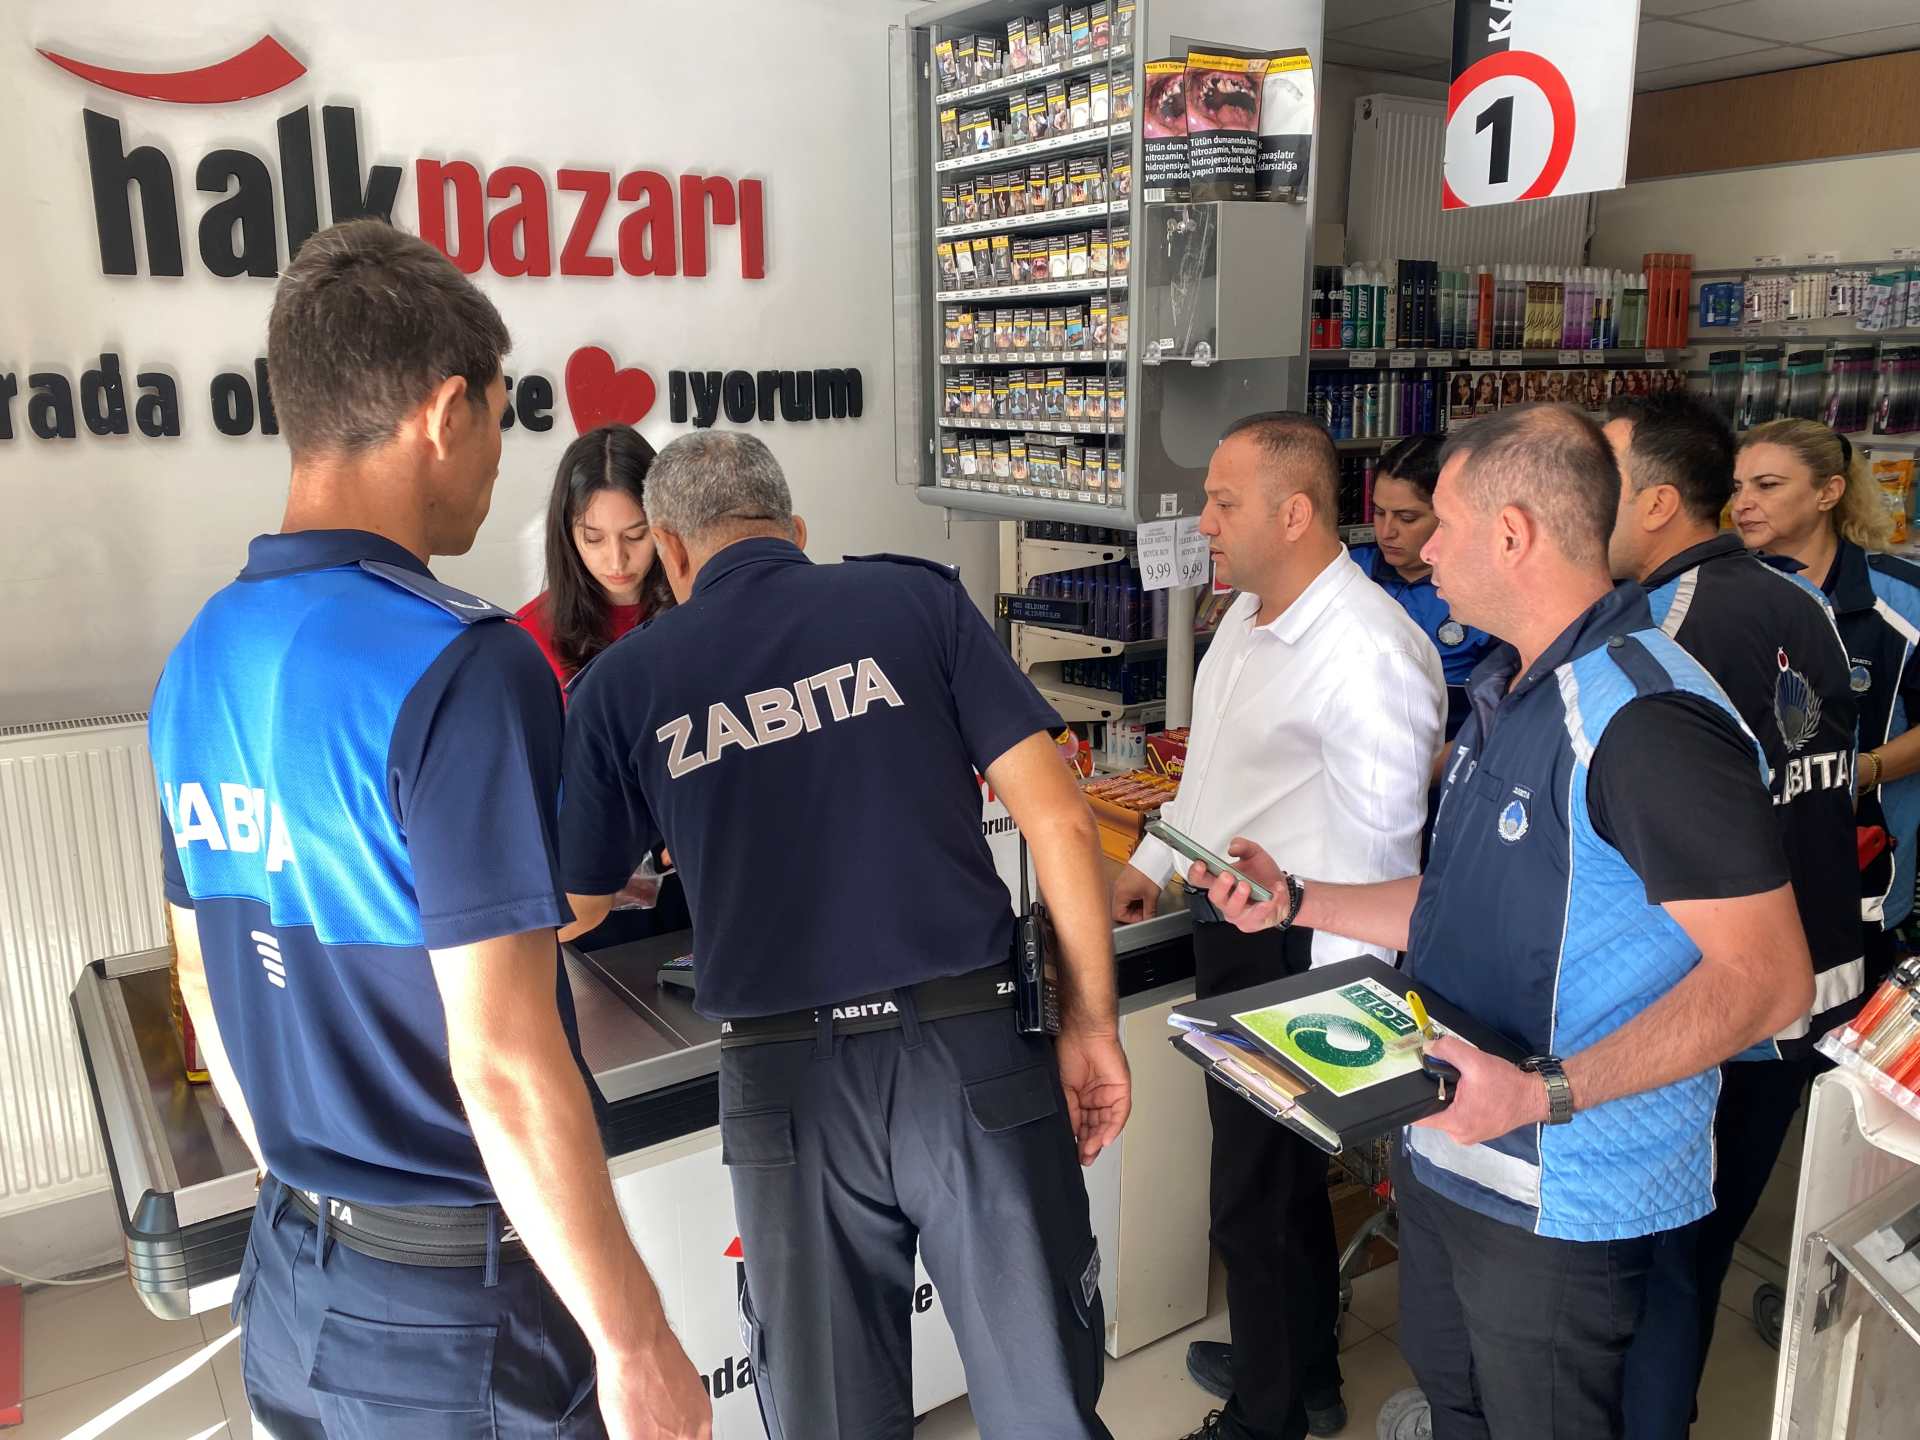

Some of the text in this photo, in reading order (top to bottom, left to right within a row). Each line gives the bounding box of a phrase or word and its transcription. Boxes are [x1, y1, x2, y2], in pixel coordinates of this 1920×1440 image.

[1190, 137, 1212, 146] Tütün
[1475, 95, 1514, 186] 1
[656, 657, 904, 780] ZABITA
